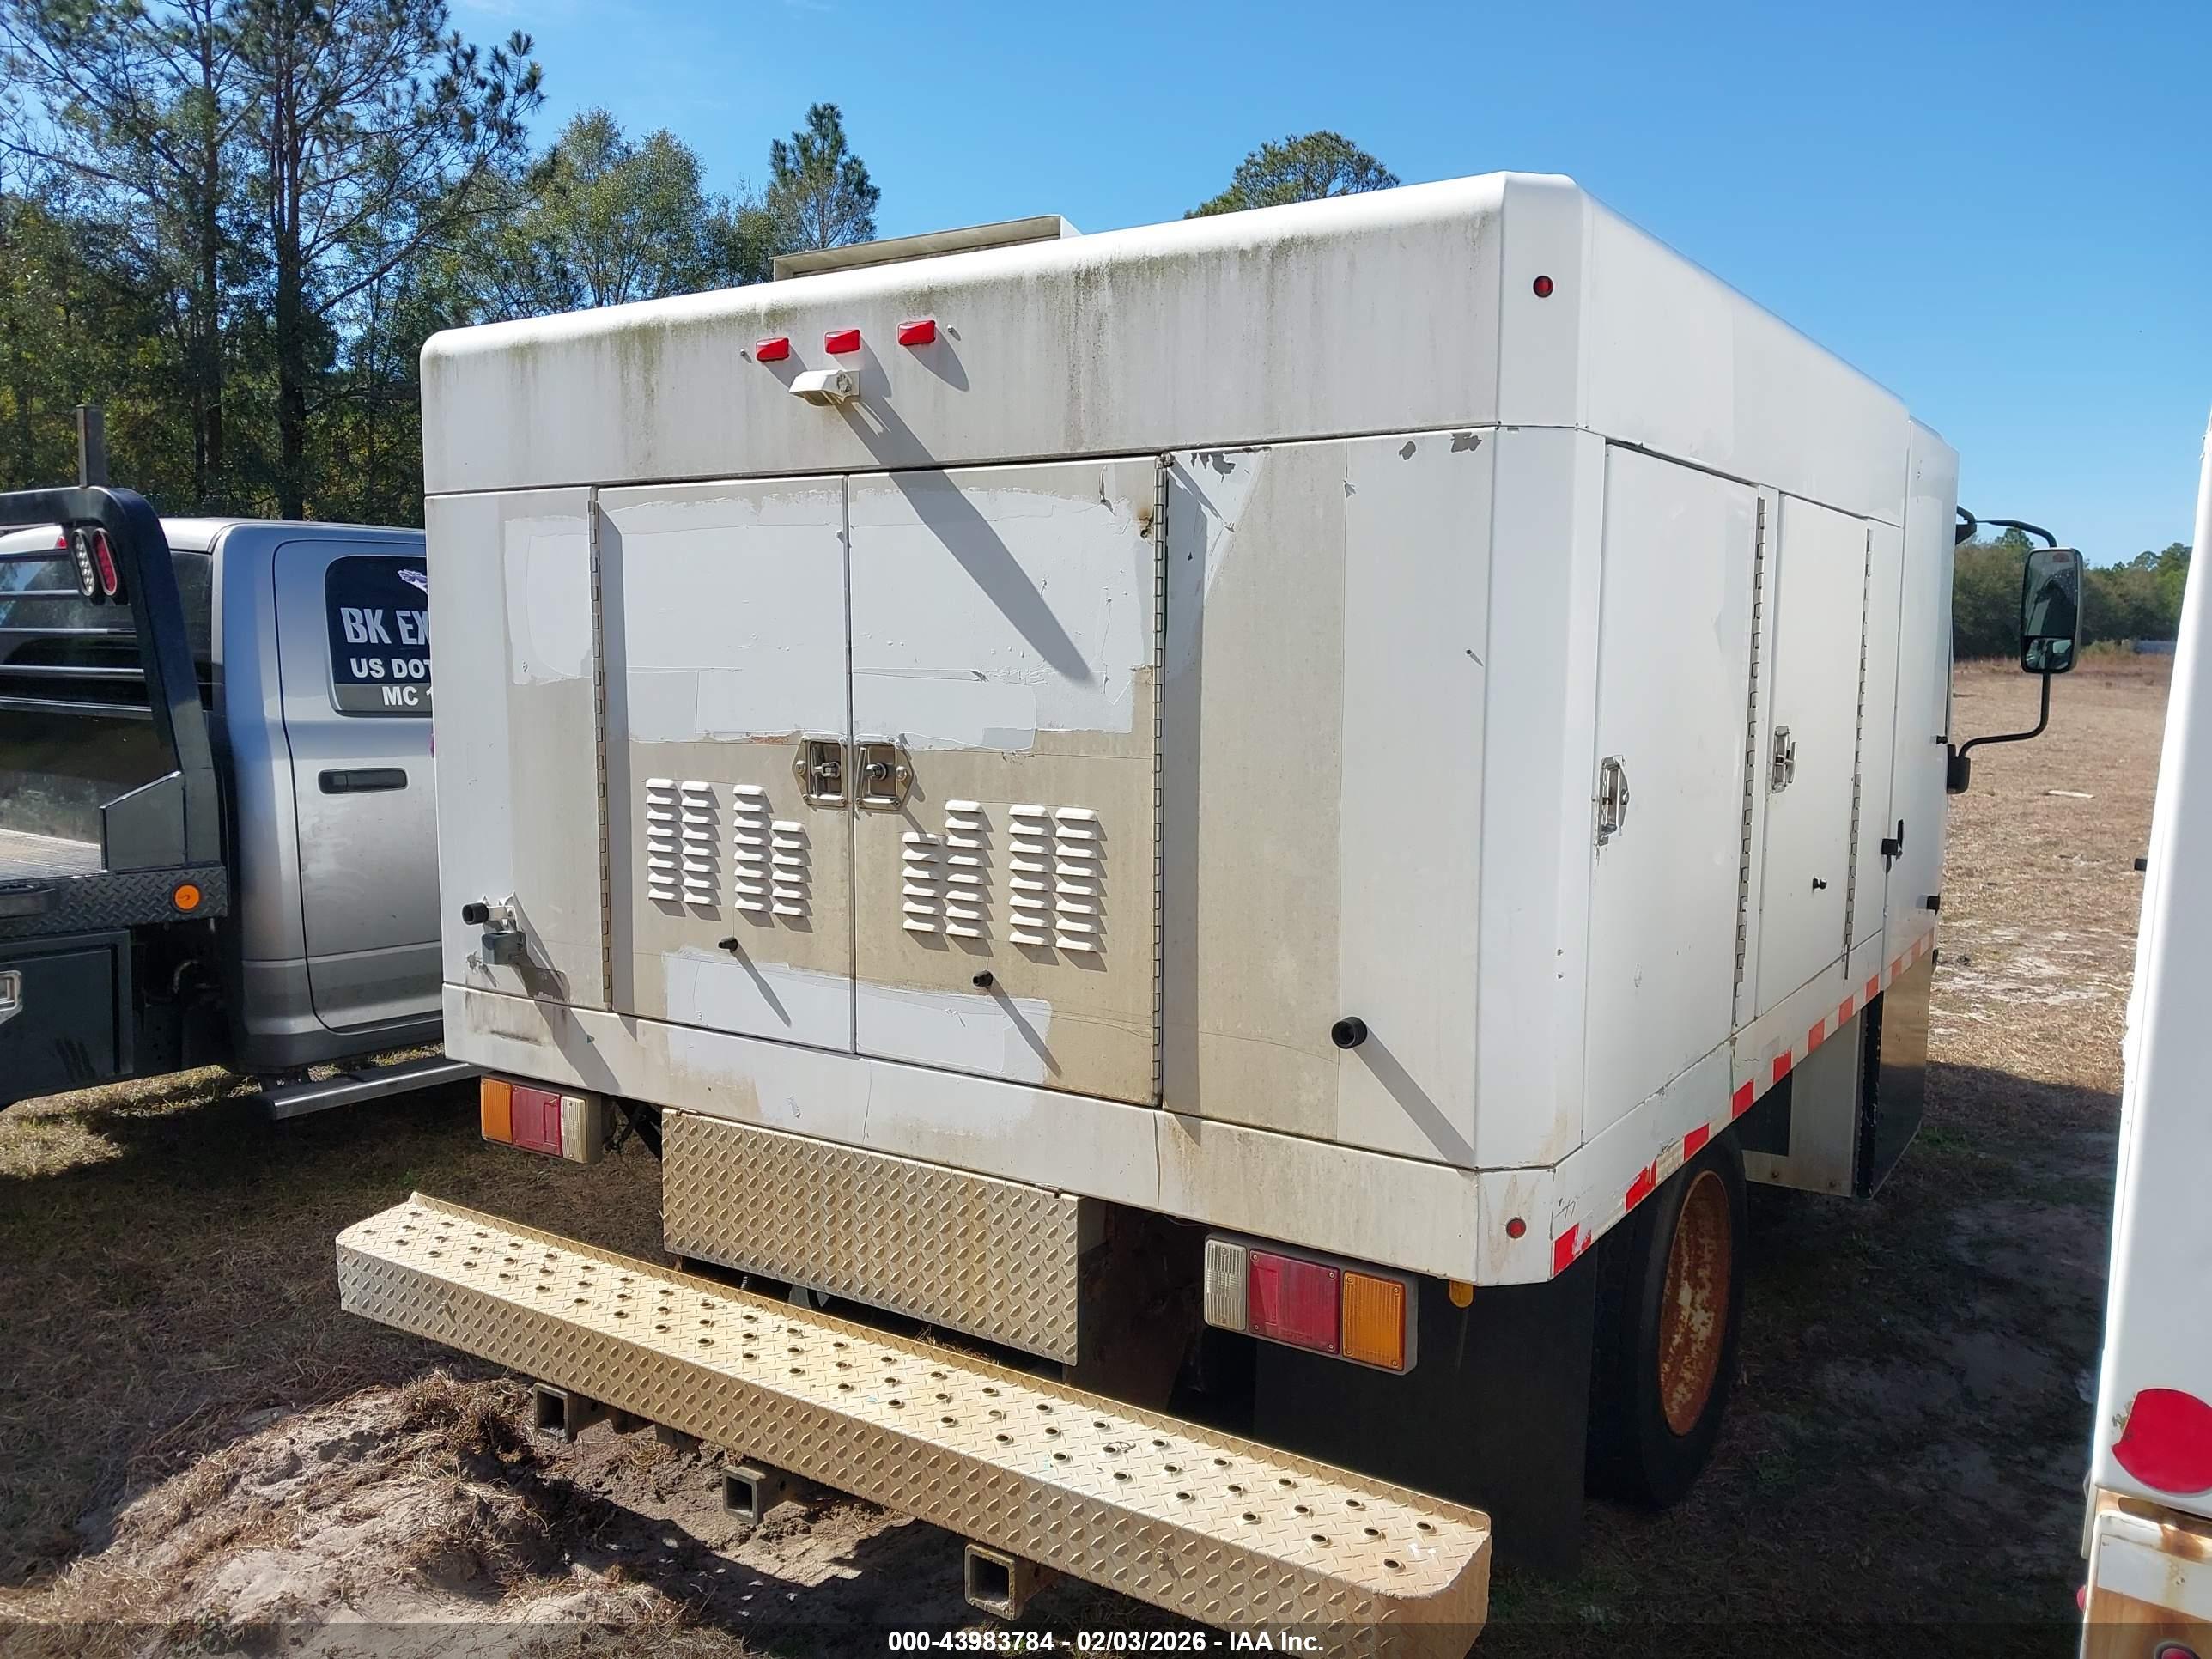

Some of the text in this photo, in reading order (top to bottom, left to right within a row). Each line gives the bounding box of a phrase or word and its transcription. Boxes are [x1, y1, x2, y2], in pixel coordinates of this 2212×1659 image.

[340, 607, 392, 644] BK
[349, 658, 385, 678] US
[382, 686, 419, 706] MC
